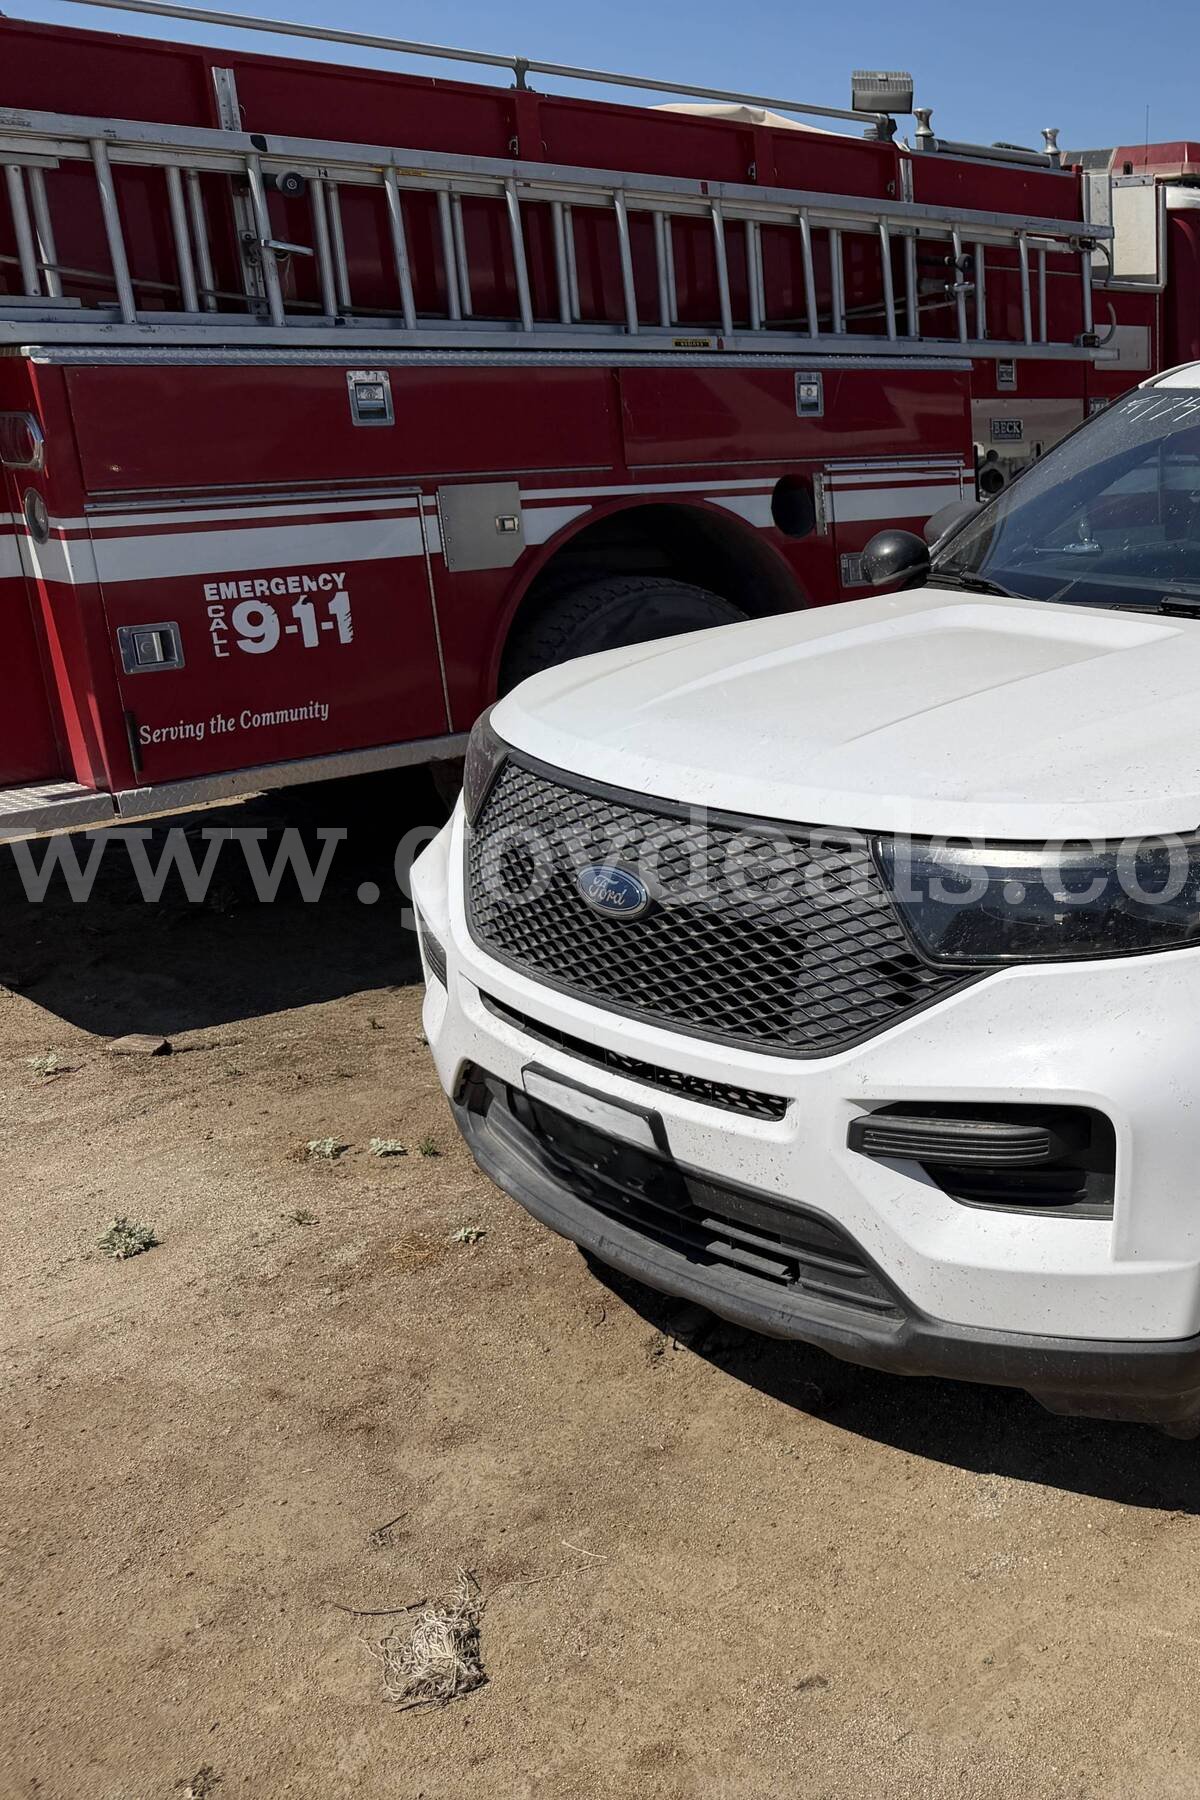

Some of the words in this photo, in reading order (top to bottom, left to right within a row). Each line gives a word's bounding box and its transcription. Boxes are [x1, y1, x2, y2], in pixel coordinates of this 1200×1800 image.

[993, 421, 1021, 434] BECK
[203, 572, 346, 601] EMERGENCY
[207, 604, 230, 658] CALL
[231, 590, 354, 654] 9-1-1
[139, 719, 205, 745] Serving
[209, 713, 236, 734] the
[239, 700, 330, 729] Community
[588, 874, 628, 906] Ford
